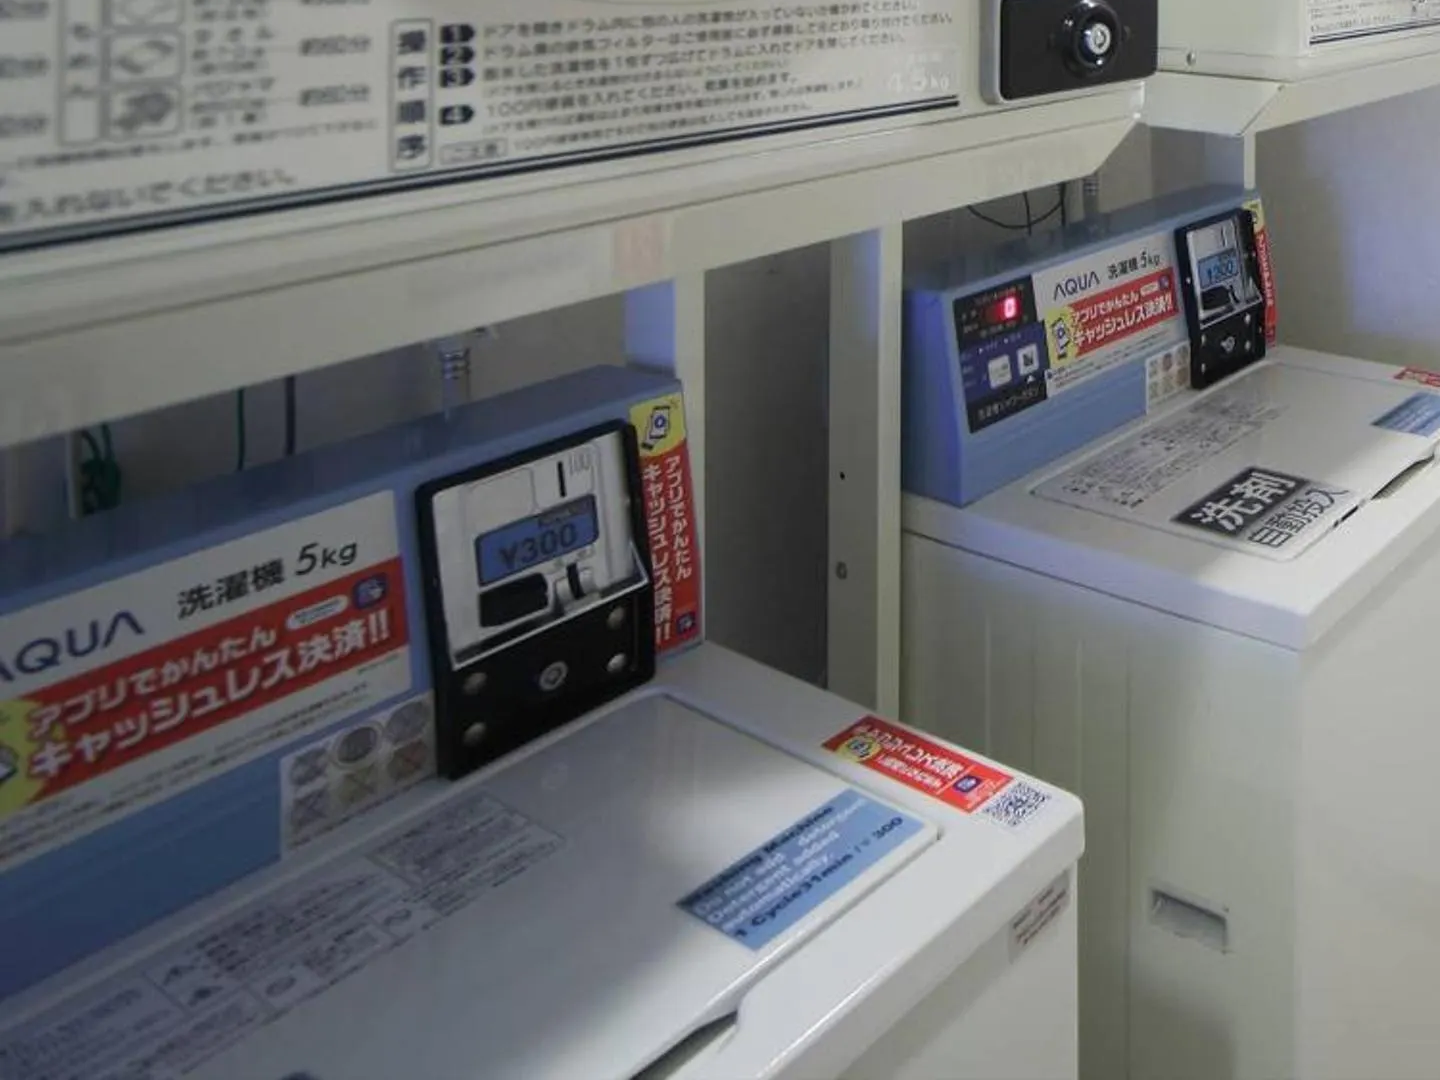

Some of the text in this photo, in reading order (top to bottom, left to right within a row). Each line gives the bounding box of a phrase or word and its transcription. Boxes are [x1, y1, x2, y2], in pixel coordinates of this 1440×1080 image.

[1053, 270, 1100, 302] AQUA
[1190, 471, 1296, 531] 洗剤
[177, 557, 286, 620] 洗濯機
[295, 541, 359, 578] 5kg
[29, 625, 277, 739] アプリでかんたん
[30, 608, 391, 777] キャッシュレス決済!!
[871, 816, 904, 840] 300
